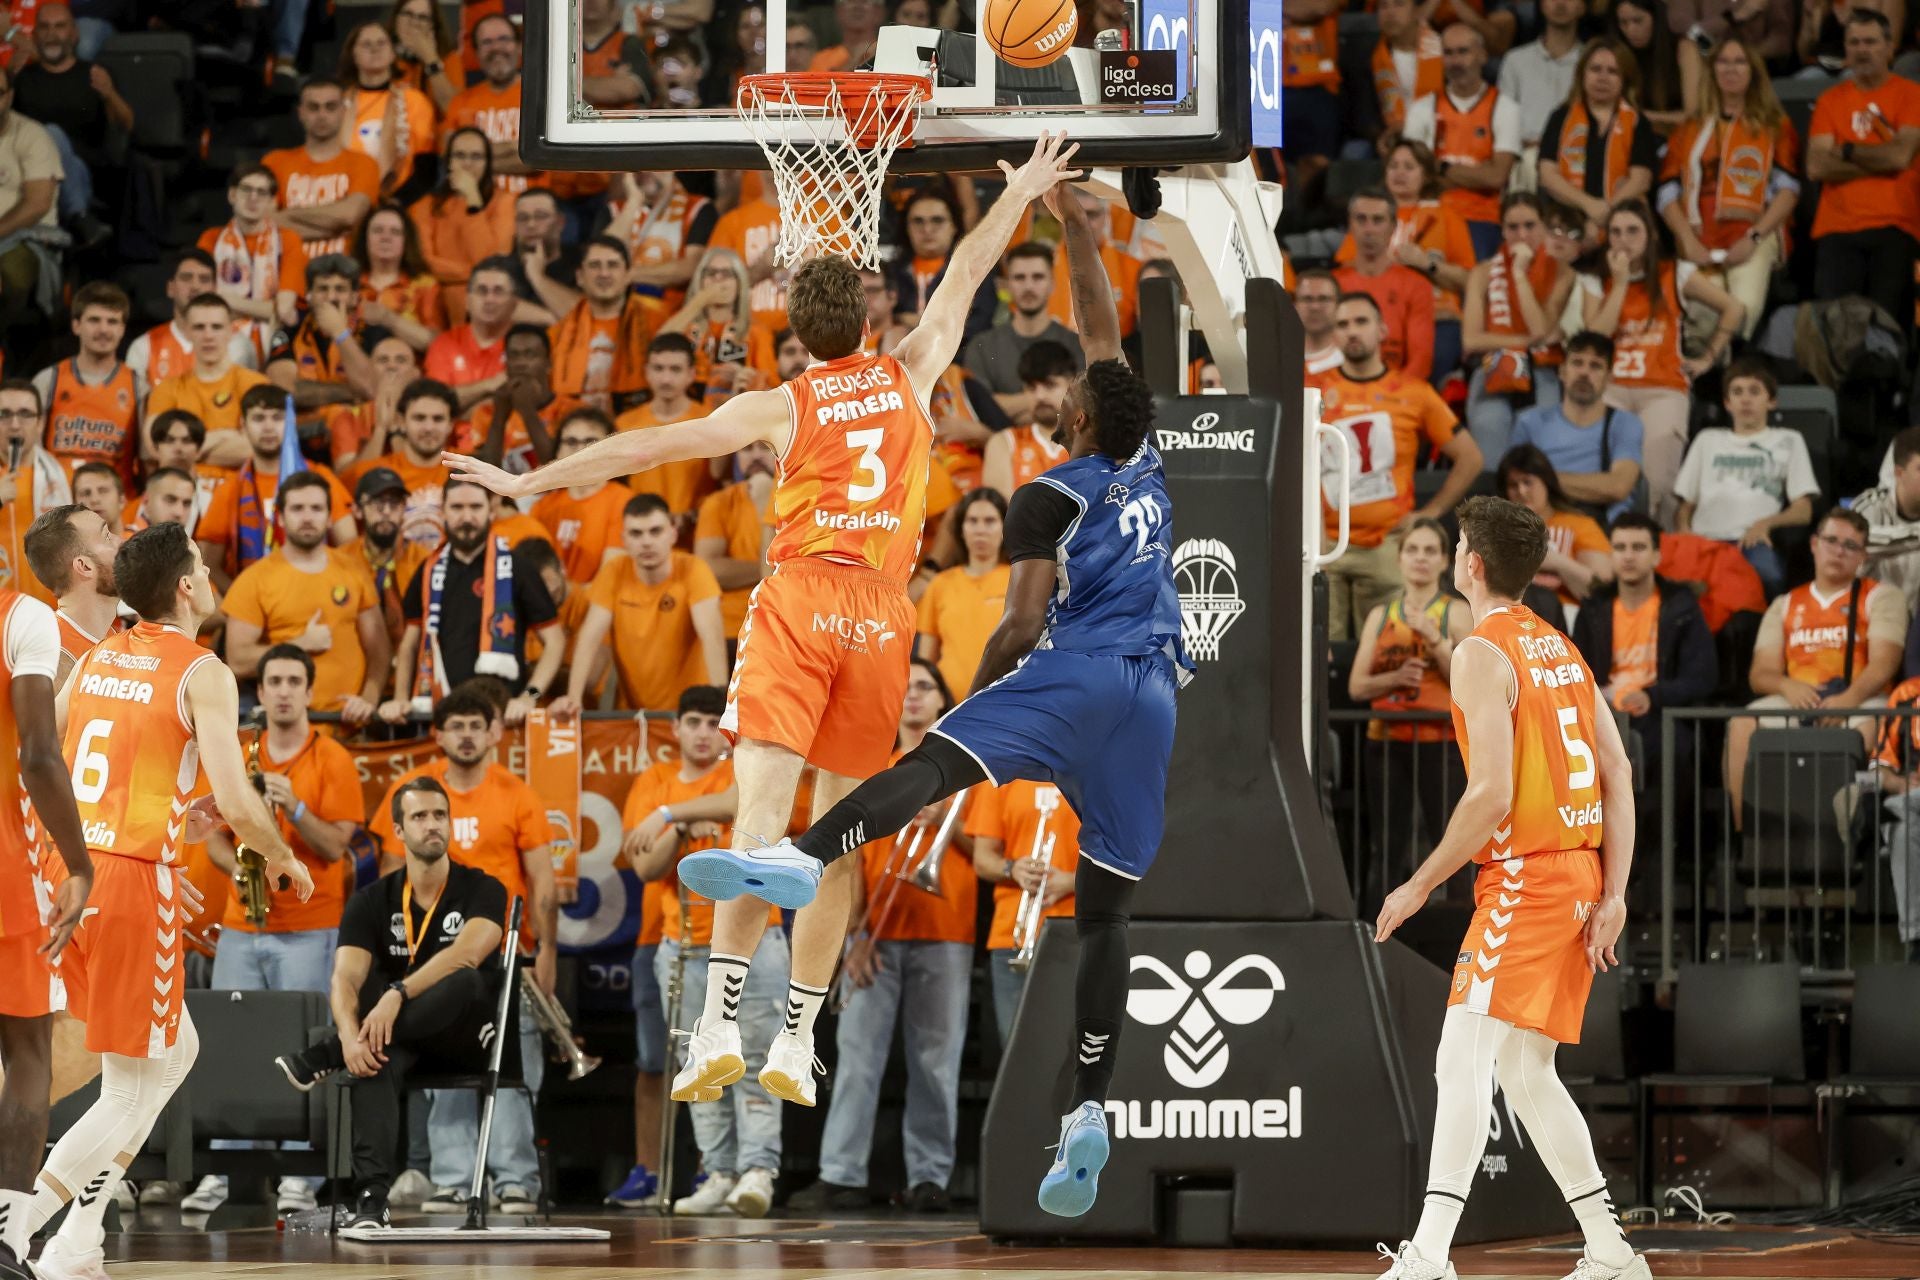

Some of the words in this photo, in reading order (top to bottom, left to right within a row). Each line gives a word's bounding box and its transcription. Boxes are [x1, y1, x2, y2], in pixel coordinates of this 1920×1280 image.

[1033, 5, 1078, 53] Wilson
[1104, 66, 1136, 83] liga
[1104, 81, 1174, 98] endesa
[1612, 349, 1647, 378] 23
[815, 390, 905, 426] PAMESA
[845, 427, 887, 502] 3
[811, 612, 867, 644] MGS
[837, 637, 868, 655] Seguros
[79, 672, 155, 705] PAMESA
[71, 717, 115, 804] 6
[1556, 706, 1596, 790] 5
